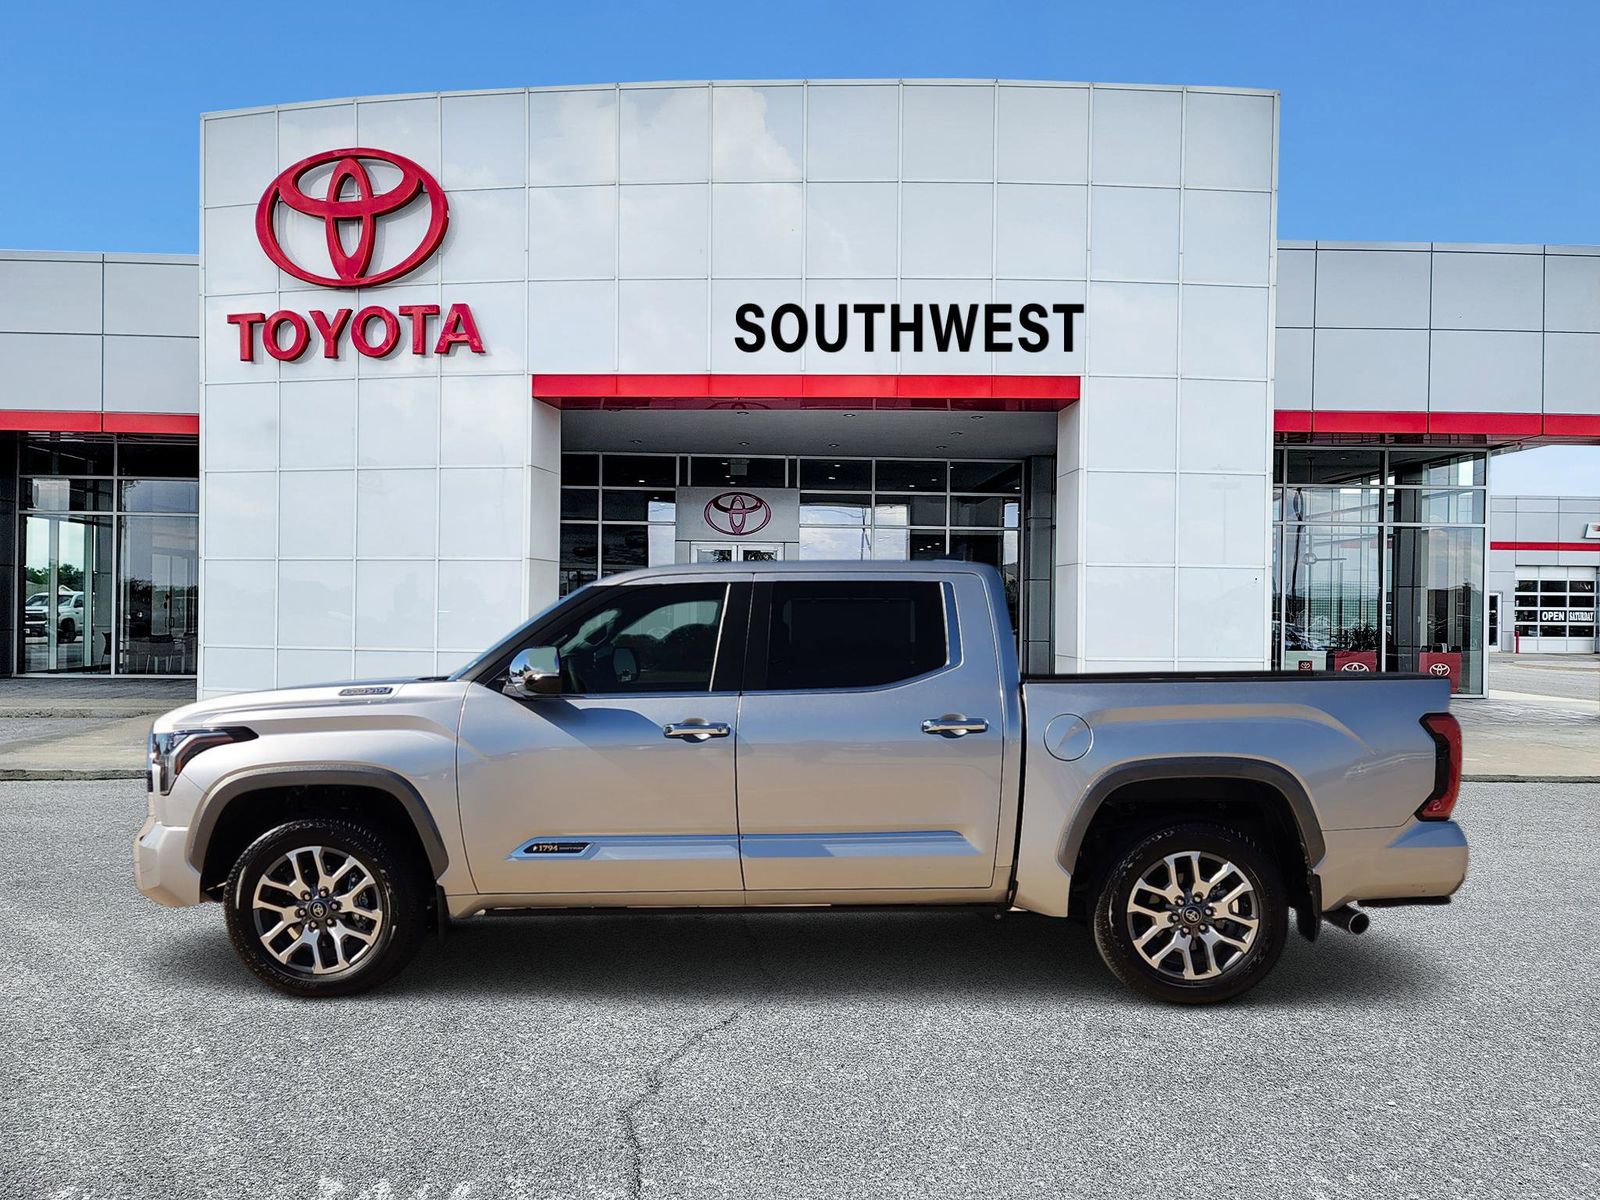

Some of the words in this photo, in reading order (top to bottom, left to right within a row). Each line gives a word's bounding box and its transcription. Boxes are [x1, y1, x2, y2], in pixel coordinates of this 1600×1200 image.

[227, 303, 486, 361] TOYOTA
[734, 302, 1084, 353] SOUTHWEST
[1541, 611, 1565, 621] OPEN
[1569, 611, 1594, 621] SATURDAY
[539, 844, 558, 852] 1794
